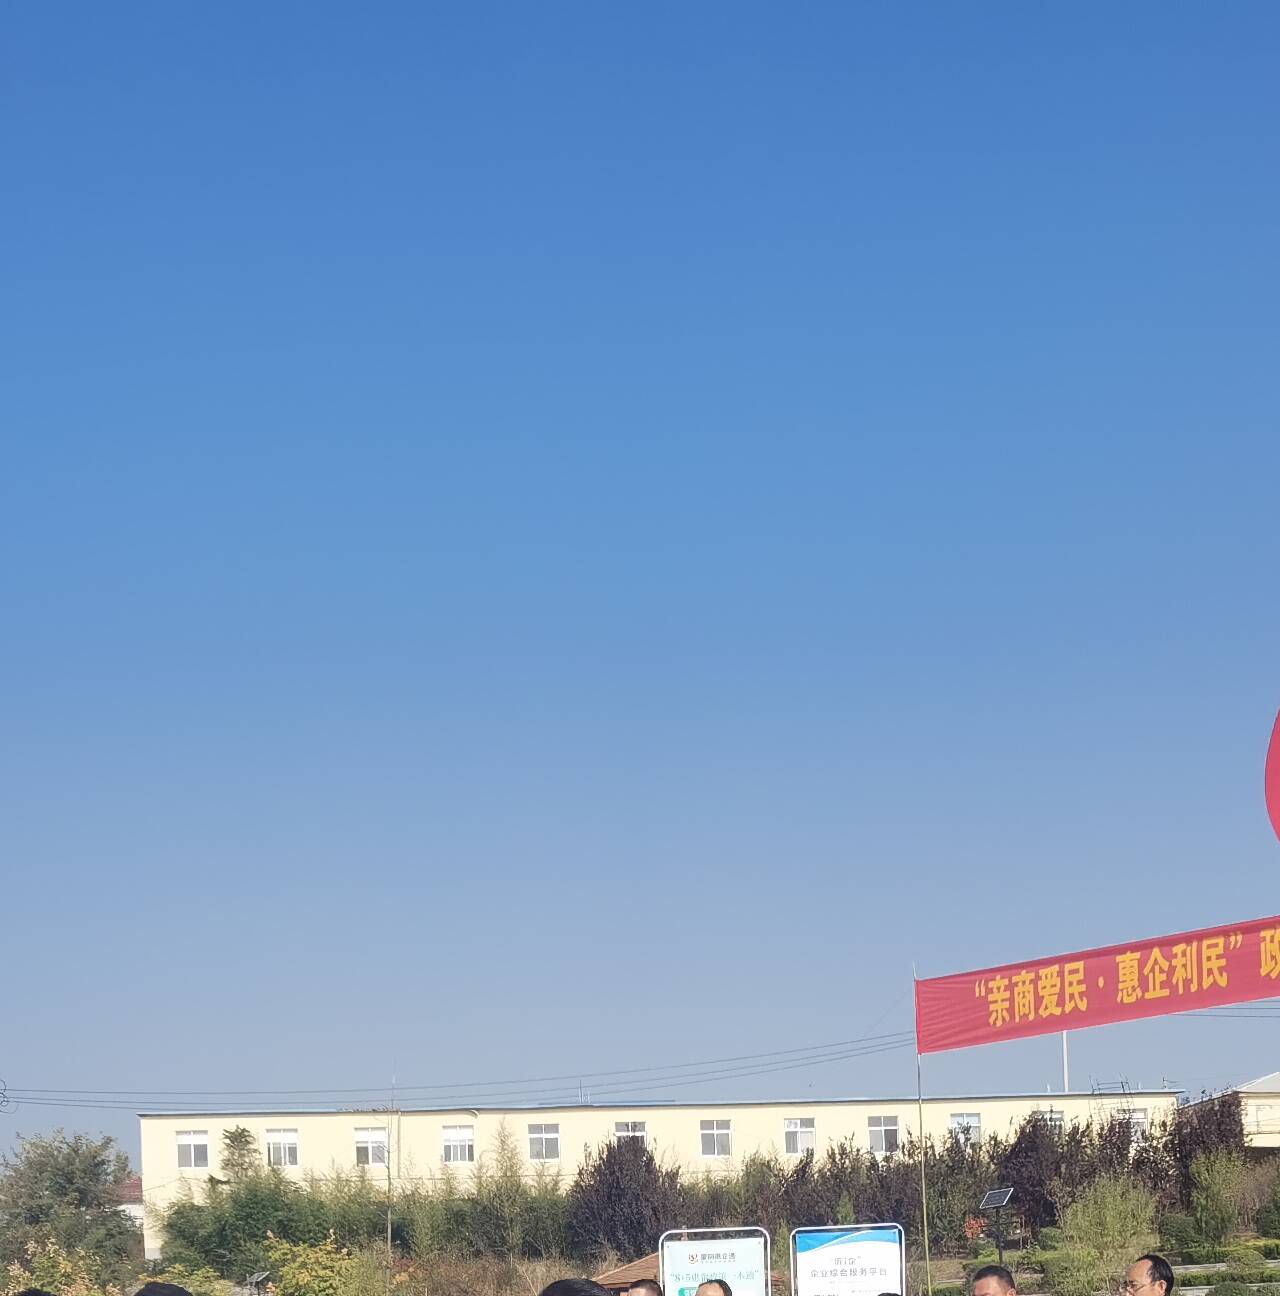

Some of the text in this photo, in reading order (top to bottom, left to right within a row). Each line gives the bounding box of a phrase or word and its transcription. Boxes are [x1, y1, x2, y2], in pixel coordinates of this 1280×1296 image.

[811, 1267, 887, 1278] 企业综合服务平台
